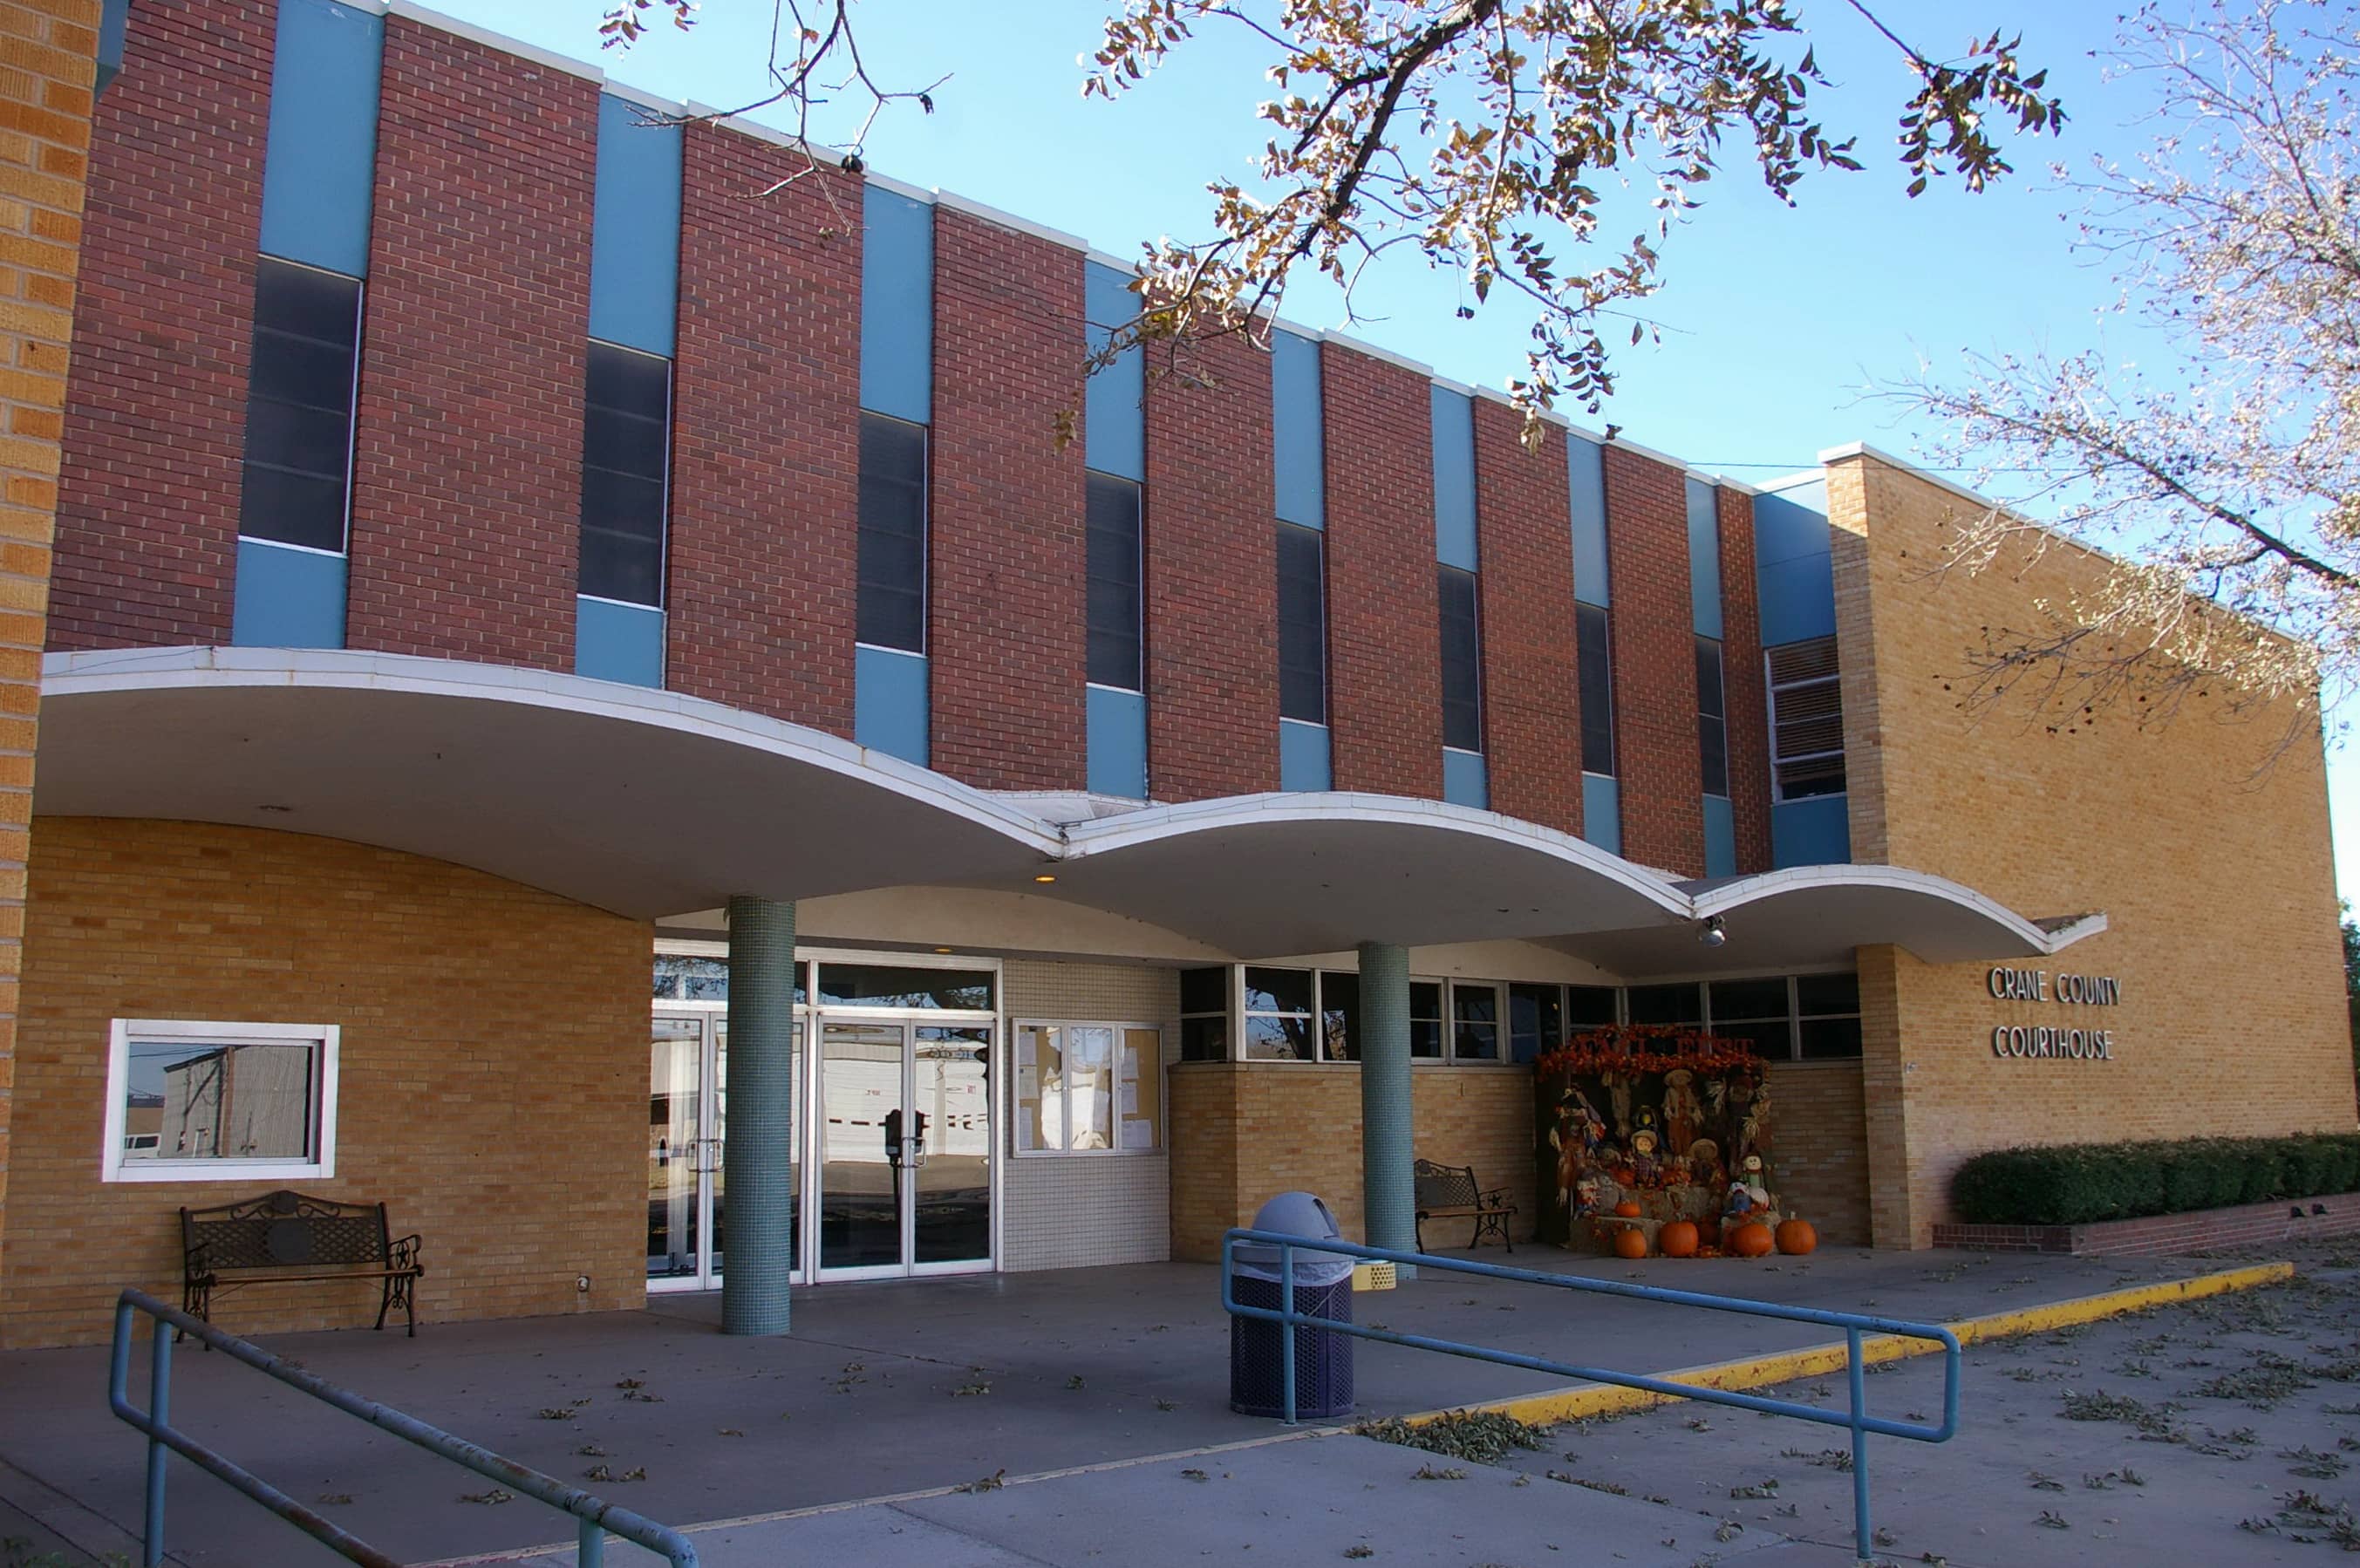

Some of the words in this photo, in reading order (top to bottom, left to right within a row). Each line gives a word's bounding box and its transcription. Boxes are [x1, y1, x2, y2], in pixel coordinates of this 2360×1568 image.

[1990, 967, 2049, 1001] CRANE
[2056, 973, 2121, 1005] COUNTY
[1994, 1026, 2114, 1060] COURTHOUSE
